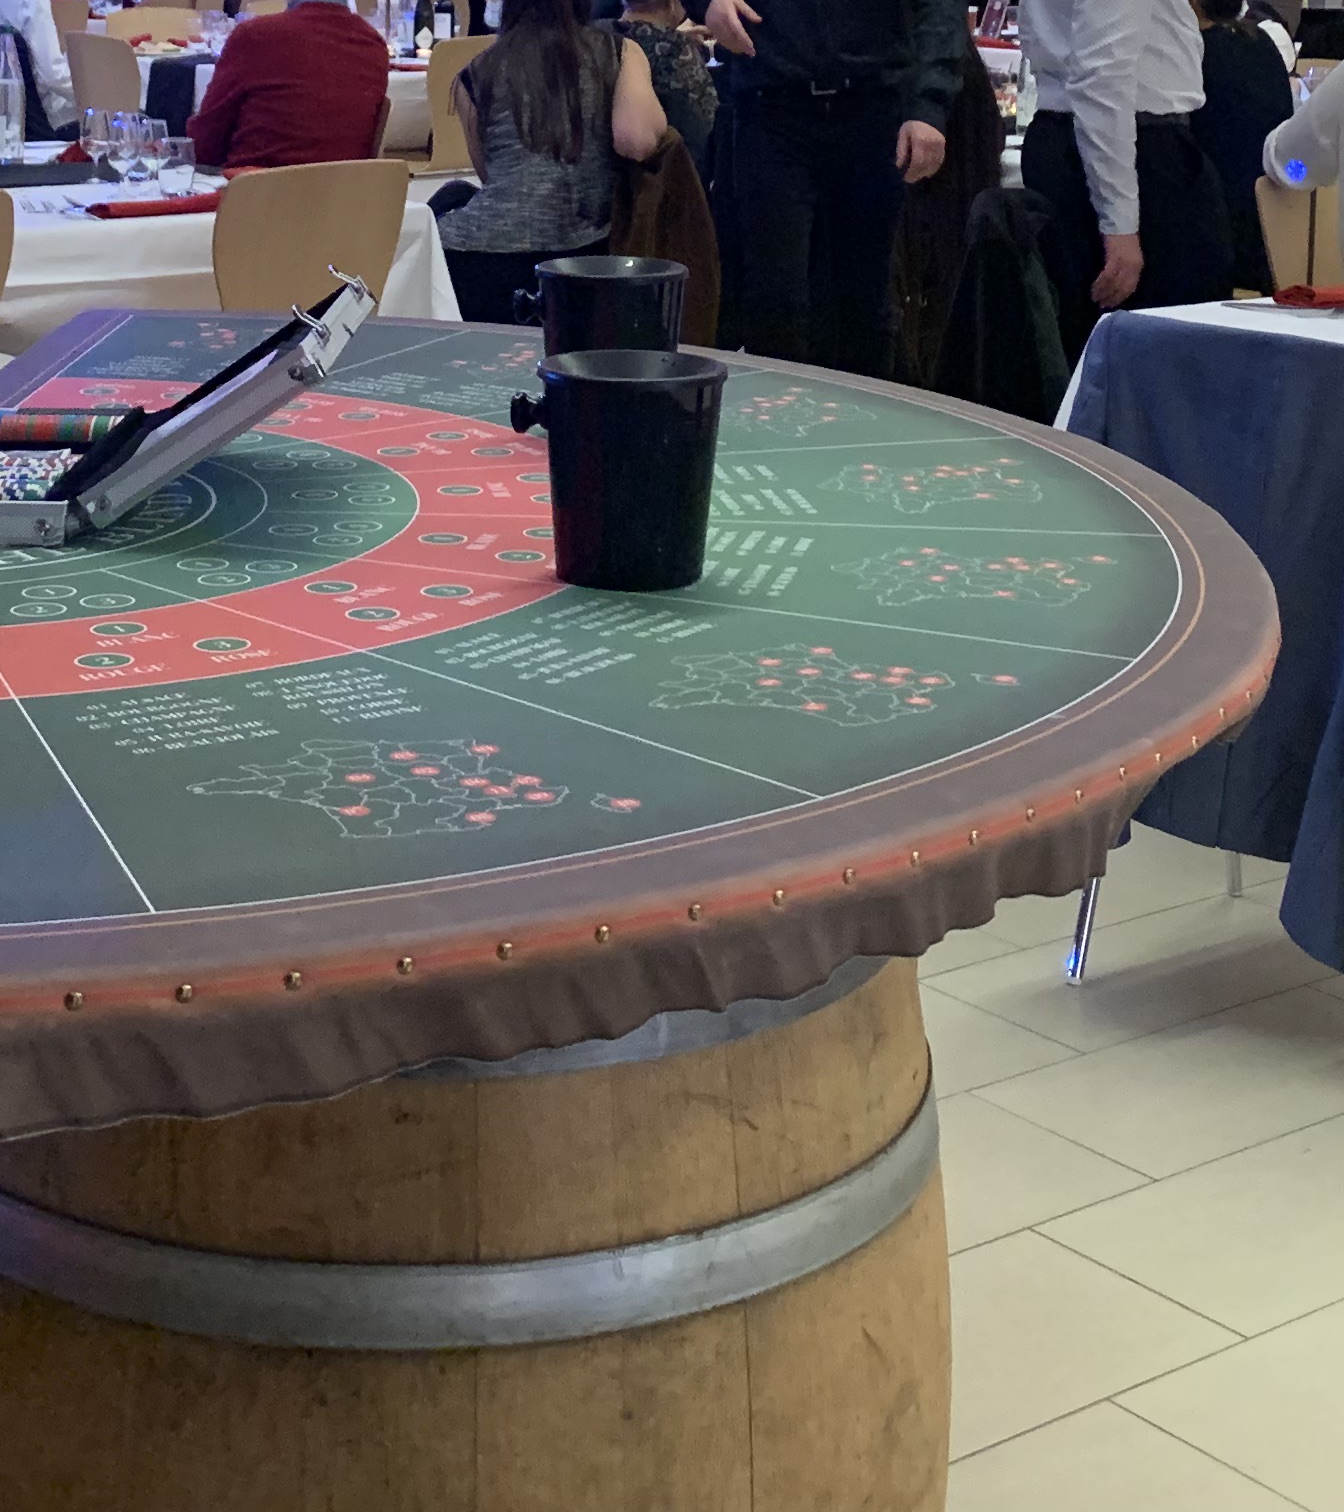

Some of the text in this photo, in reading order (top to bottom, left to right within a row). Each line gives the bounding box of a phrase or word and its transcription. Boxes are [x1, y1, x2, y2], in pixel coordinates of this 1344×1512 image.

[96, 631, 180, 648] BLANC
[95, 656, 115, 665] 2
[210, 648, 278, 664] ROSE
[79, 662, 171, 682] ROUGE
